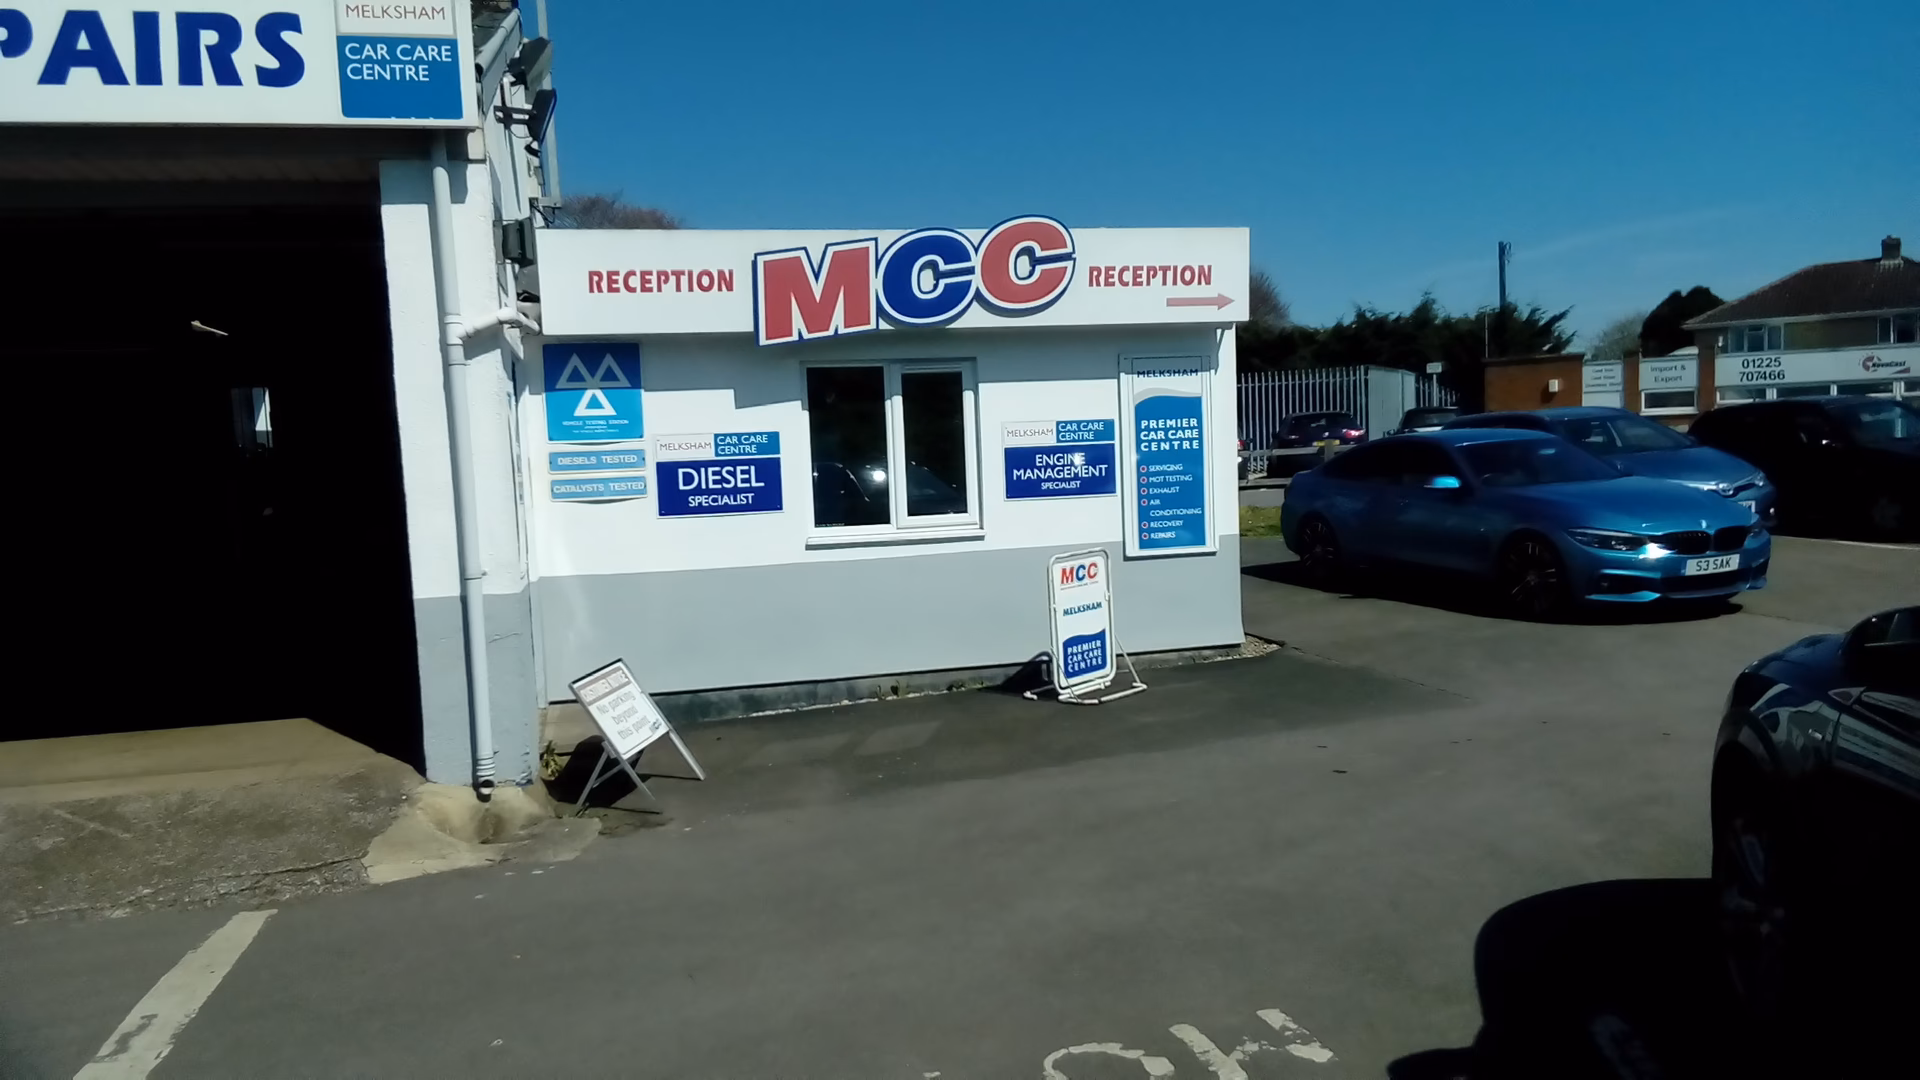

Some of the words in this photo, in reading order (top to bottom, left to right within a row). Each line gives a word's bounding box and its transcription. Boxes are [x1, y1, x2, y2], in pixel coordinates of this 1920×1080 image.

[345, 3, 446, 21] MELKSHAM
[345, 43, 391, 61] CAR
[396, 44, 452, 62] CARE
[346, 63, 430, 82] CENTRE
[588, 269, 734, 294] RECEPTION
[753, 215, 1076, 346] MCC
[1088, 264, 1213, 289] RECEPTION
[1650, 364, 1677, 374] Import
[1742, 356, 1781, 369] 01225
[1136, 368, 1199, 378] MELKSHAM
[1654, 375, 1682, 384] Export
[1738, 369, 1785, 382] 707466
[1058, 422, 1078, 432] CAR
[1080, 421, 1104, 431] CARE
[1140, 418, 1198, 429] PREMIER
[1007, 427, 1053, 438] MELKSHAM
[1059, 431, 1095, 441] CENTRE
[1140, 430, 1165, 440] CAR
[1167, 429, 1199, 439] CARE
[717, 435, 739, 445] CAR
[741, 434, 768, 444] CARE
[1140, 440, 1200, 451] CENTRE
[660, 441, 712, 452] MELKSHAM
[717, 445, 757, 455] CENTRE
[557, 456, 597, 466] DIESELS
[601, 454, 637, 464] TESTED
[1035, 452, 1085, 467] ENGINE
[1012, 464, 1108, 480] MANAGEMENT
[1149, 463, 1183, 472] SERVICING
[677, 465, 764, 490] DIESEL
[1149, 474, 1165, 483] MOT
[1166, 474, 1193, 482] TESTING
[553, 483, 604, 494] CATALYSTS
[608, 481, 645, 491] TESTED
[1041, 480, 1081, 490] SPECIALIST
[688, 493, 754, 507] SPECIALIST
[1150, 520, 1183, 528] RECOVERY
[1150, 531, 1176, 539] REPAIRS
[1696, 560, 1710, 572] S3
[1712, 557, 1731, 570] SAK
[1060, 562, 1098, 584] MCC
[1063, 601, 1102, 616] MELKSHAM
[1067, 639, 1101, 655] PREMIER
[1067, 652, 1084, 664] CAR
[1084, 647, 1102, 660] CARE
[1067, 656, 1102, 672] CENTRE
[596, 703, 609, 715] No
[608, 690, 636, 712] parking
[611, 704, 639, 725] beyond
[617, 726, 633, 740] this
[632, 714, 651, 734] point
